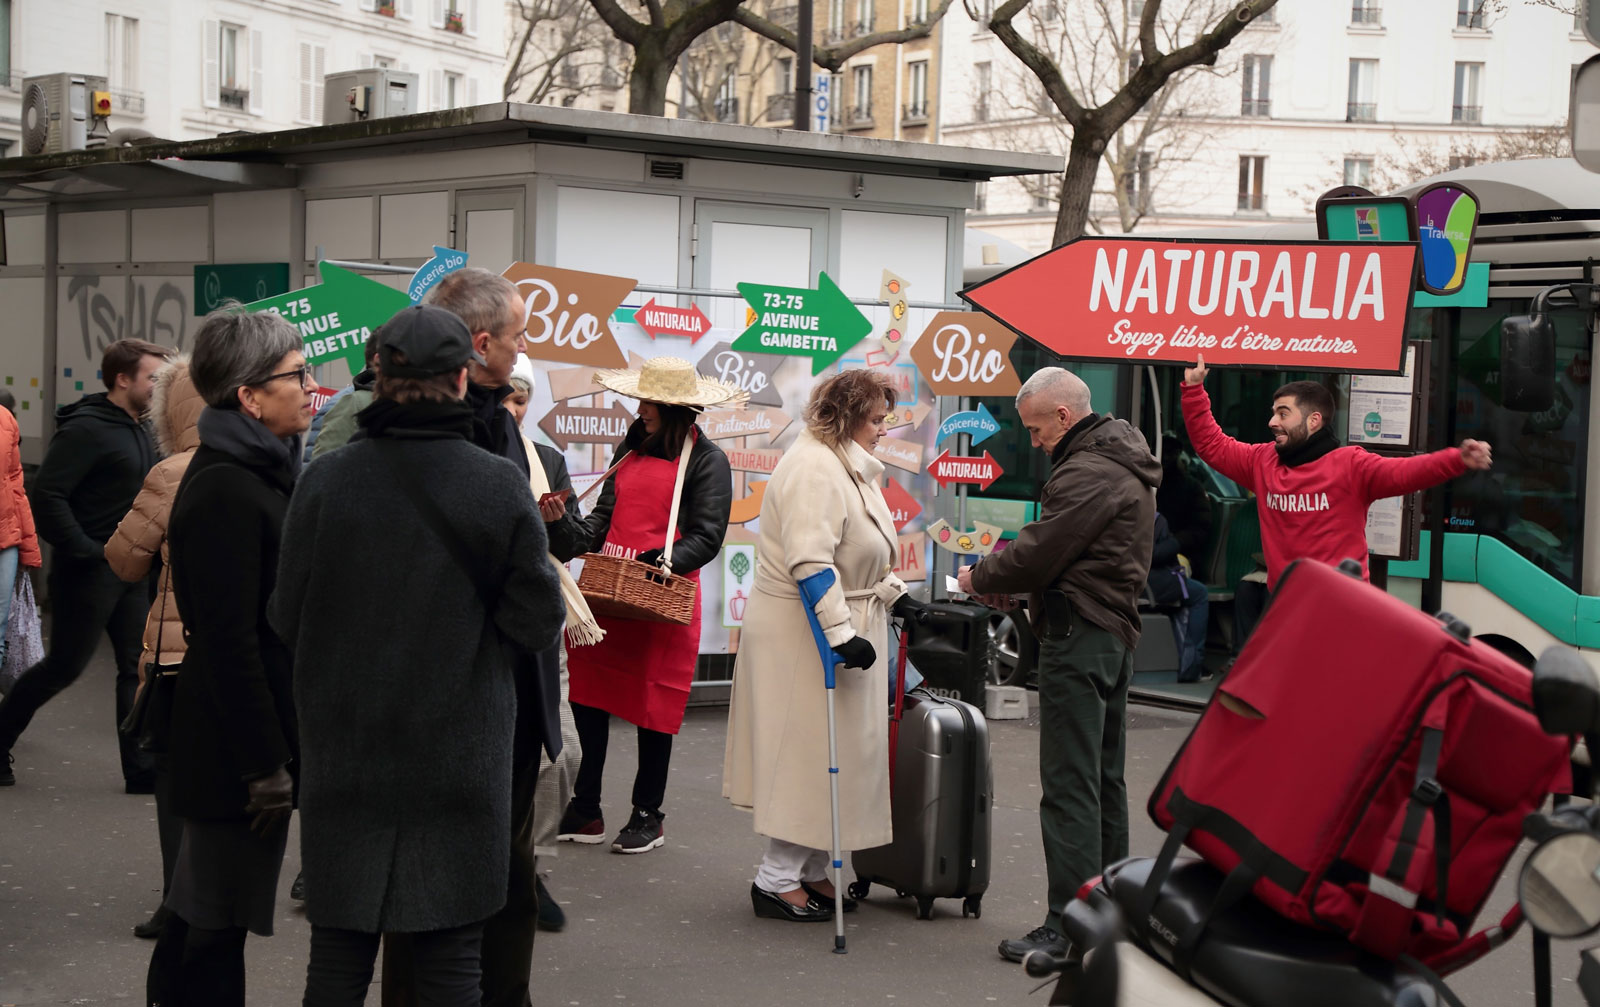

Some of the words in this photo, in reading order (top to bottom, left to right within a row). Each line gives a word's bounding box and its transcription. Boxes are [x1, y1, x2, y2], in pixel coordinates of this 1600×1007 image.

[817, 76, 828, 131] HOT
[410, 264, 446, 302] Epicerie
[445, 255, 464, 269] bio
[1089, 247, 1385, 321] NATURALIA
[514, 278, 603, 350] Bio
[763, 293, 803, 310] 73-75
[298, 312, 342, 337] NUE
[645, 309, 702, 333] NATURALIA
[761, 312, 820, 331] AVENUE
[300, 326, 371, 359] MBETTA
[760, 331, 838, 352] GAMBETTA
[1107, 319, 1165, 355] Soyez
[1169, 324, 1218, 348] libre
[1220, 325, 1284, 350] d'être
[1284, 331, 1358, 354] nature.
[931, 323, 1006, 384] Bio
[713, 350, 769, 394] Bio
[555, 414, 628, 437] NATURALIA
[942, 417, 979, 435] Epicerie
[980, 418, 996, 433] bio
[937, 461, 994, 480] NATURALIA
[1266, 488, 1330, 512] NATURALIA
[1449, 516, 1475, 527] Gruau
[1147, 914, 1179, 946] PEUGE
